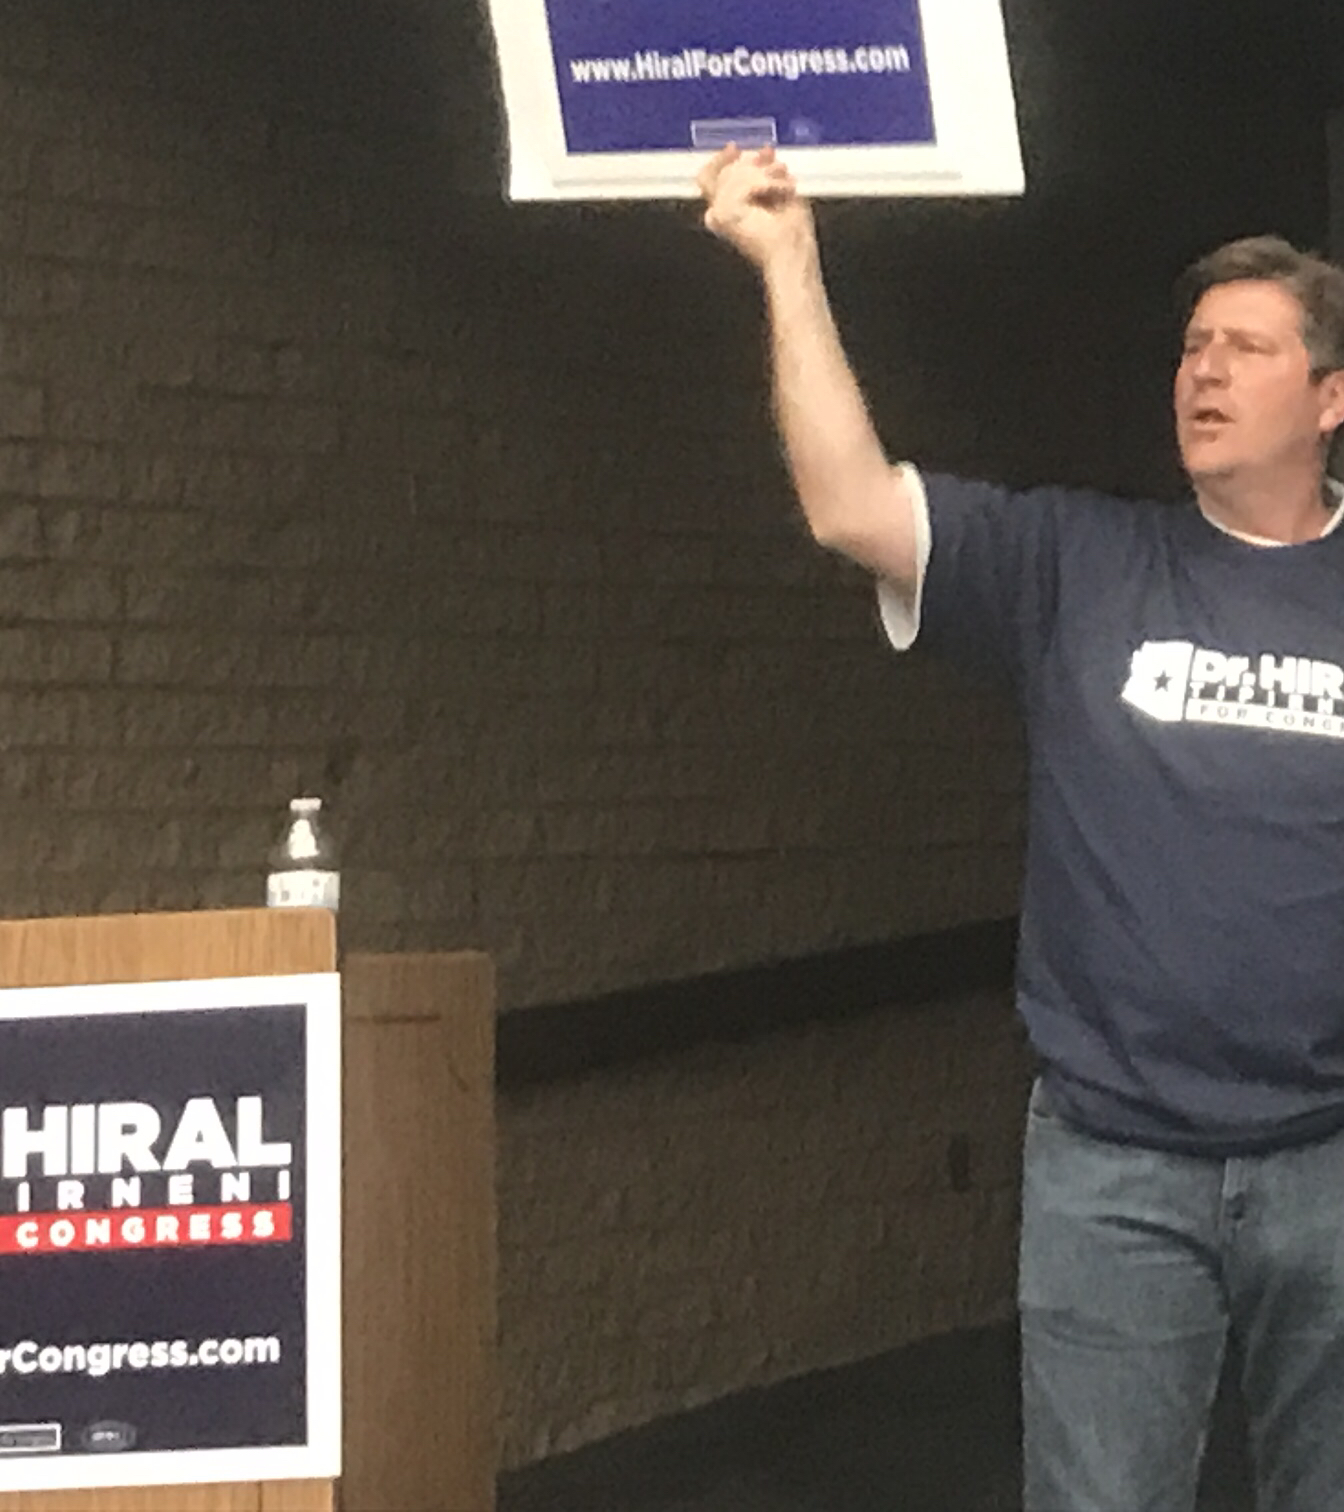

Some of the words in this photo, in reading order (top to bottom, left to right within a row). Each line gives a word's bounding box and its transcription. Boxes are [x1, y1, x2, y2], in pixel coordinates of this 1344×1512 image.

[570, 44, 911, 81] www.HiralForCongress.com
[2, 1095, 292, 1178] HIRAL
[15, 1210, 275, 1249] CONGRESS
